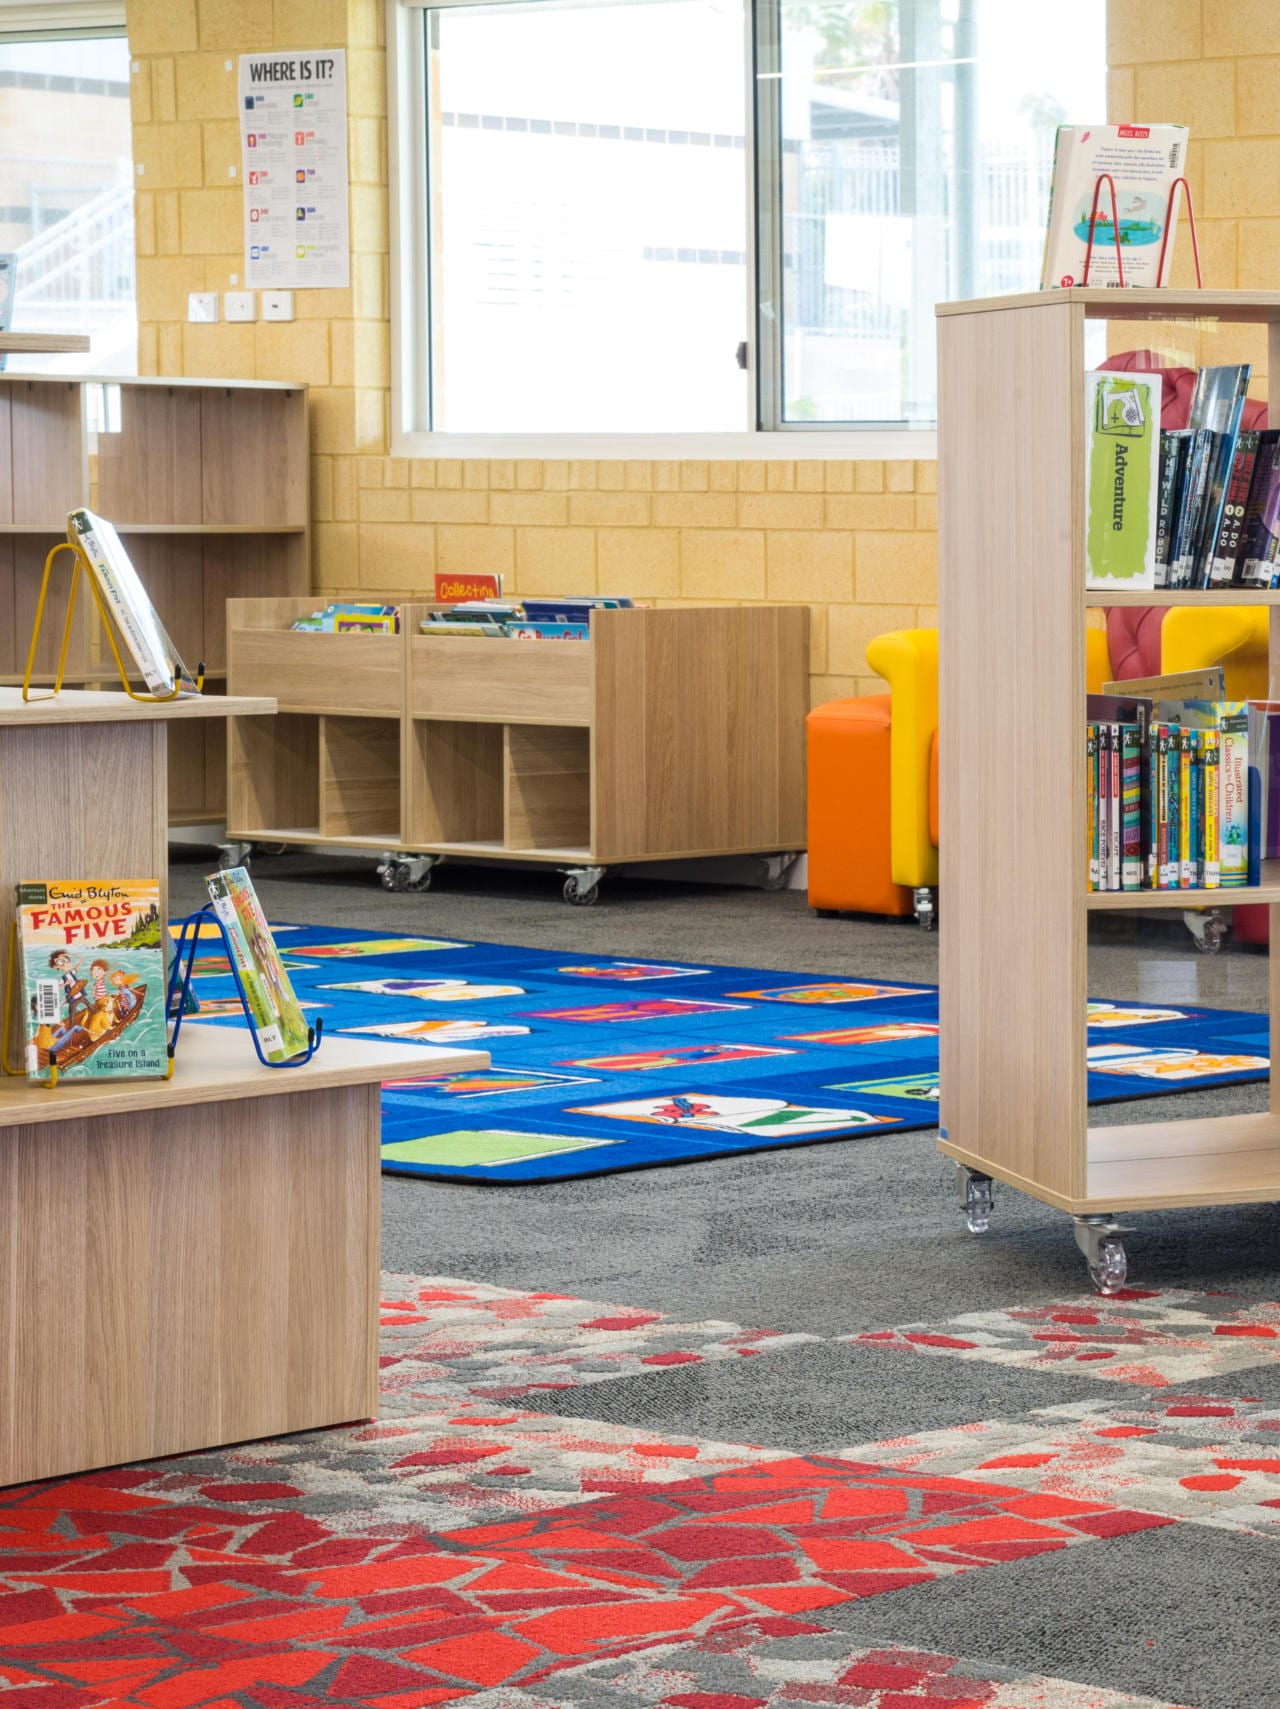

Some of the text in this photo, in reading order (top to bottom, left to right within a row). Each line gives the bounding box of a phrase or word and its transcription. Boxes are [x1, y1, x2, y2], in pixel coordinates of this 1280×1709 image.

[250, 59, 334, 82] WHERE IS IT?
[1112, 443, 1129, 532] Adventure
[1160, 481, 1172, 515] WILD
[1155, 519, 1166, 564] ROBOT
[1220, 519, 1231, 547] A. DO
[1229, 519, 1240, 547] A. DO
[1224, 737, 1235, 774] Classics
[1235, 757, 1243, 803] Illustrated
[1225, 782, 1236, 823] Children
[49, 887, 129, 901] Enid Blyton
[51, 901, 72, 910] THE
[30, 902, 132, 930] FAMOUS
[63, 918, 127, 945] FIVE
[238, 953, 247, 969] FIVE
[264, 1034, 276, 1043] BLY
[96, 1059, 160, 1069] Treasure Island
[108, 1050, 125, 1058] Five
